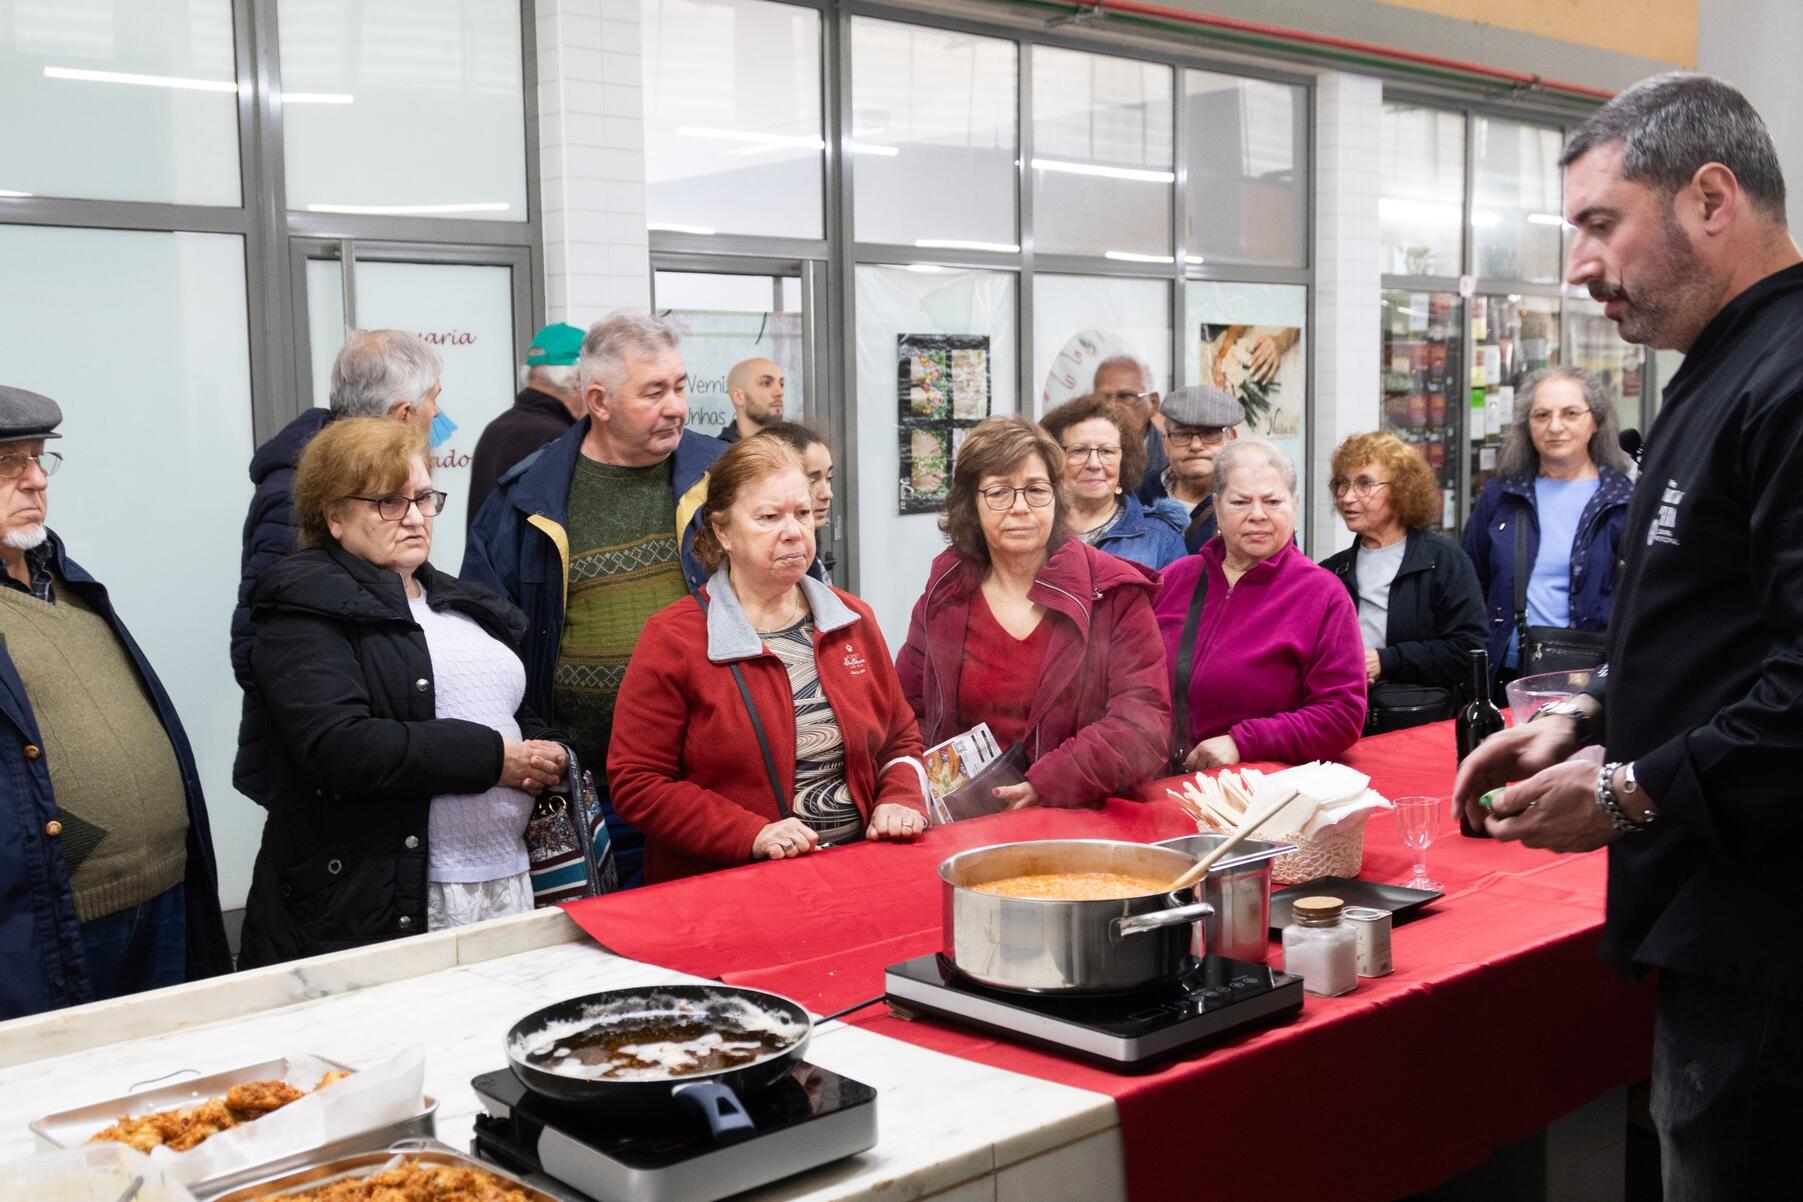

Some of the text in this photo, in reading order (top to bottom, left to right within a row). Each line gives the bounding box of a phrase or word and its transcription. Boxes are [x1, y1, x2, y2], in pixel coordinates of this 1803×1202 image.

[418, 329, 478, 345] aria
[687, 374, 729, 394] Verni
[431, 449, 472, 468] ado
